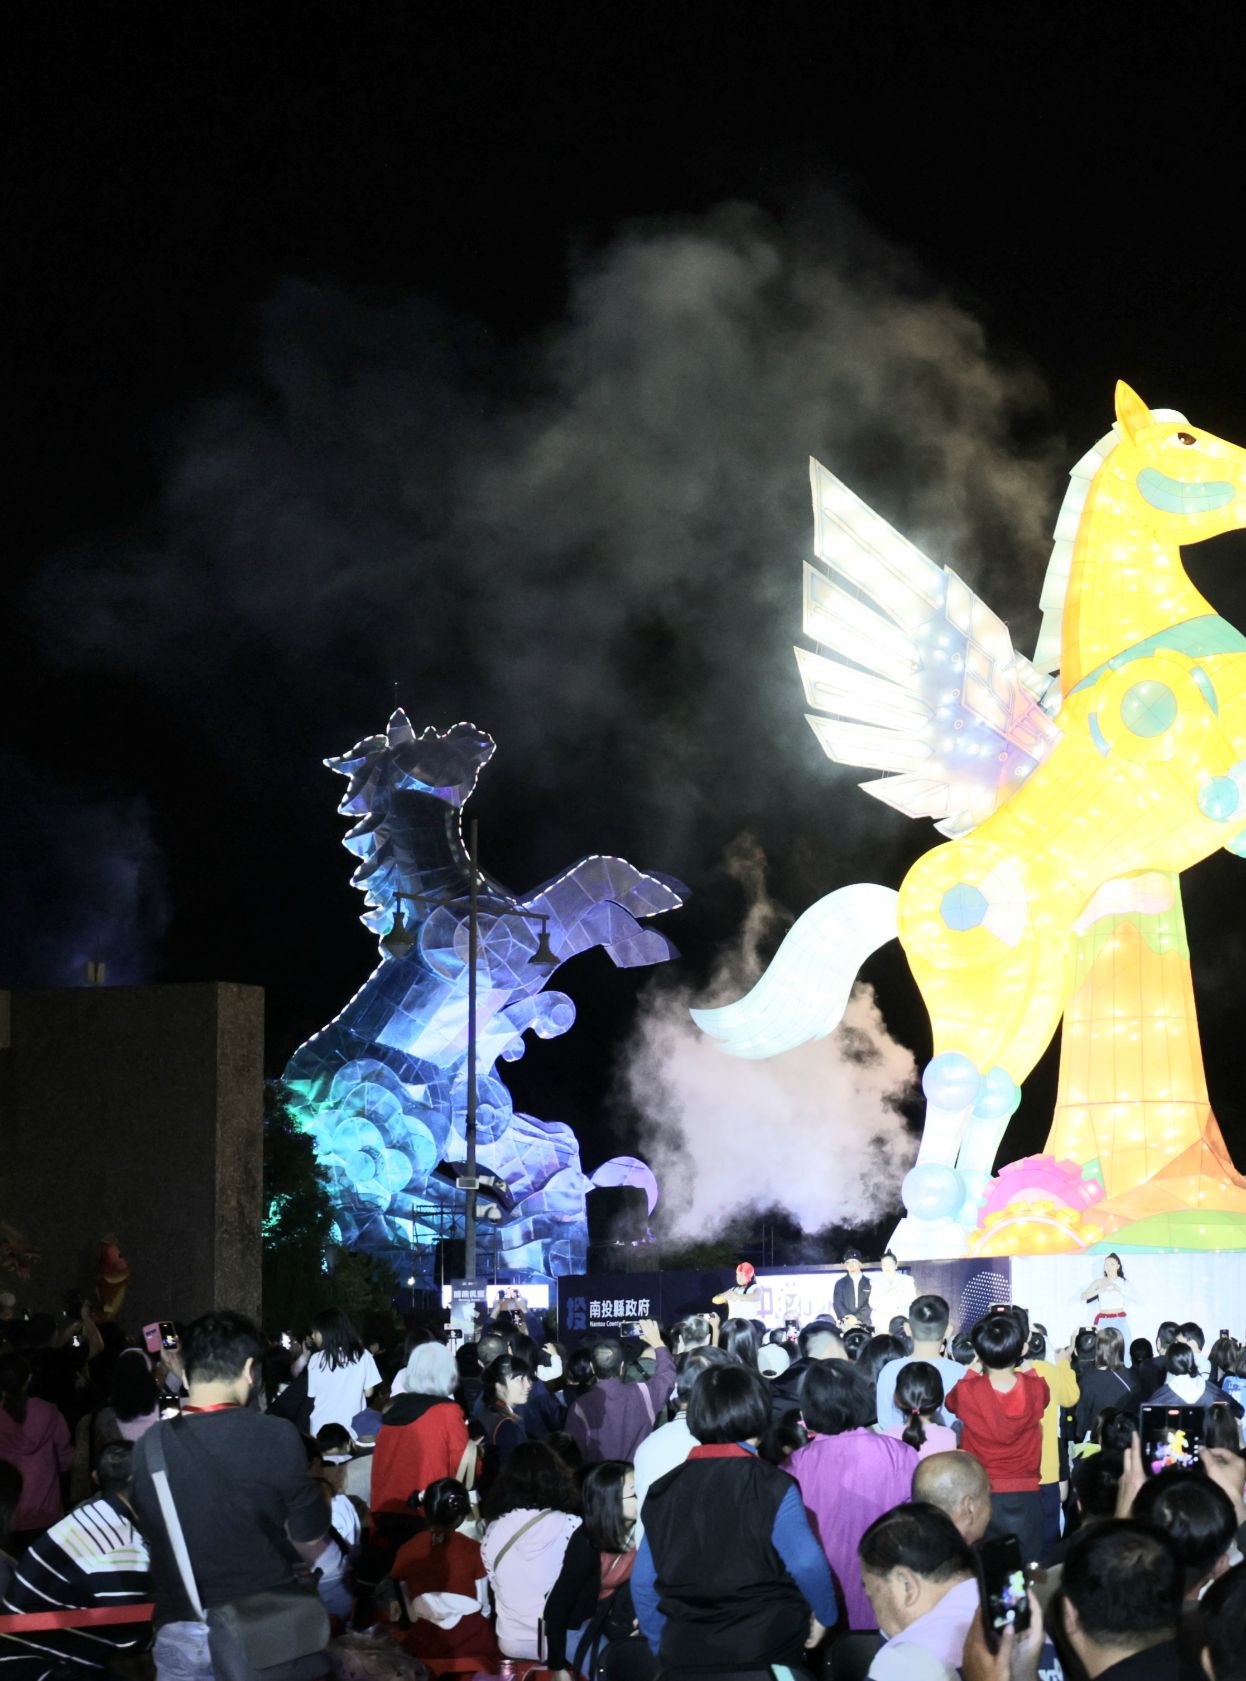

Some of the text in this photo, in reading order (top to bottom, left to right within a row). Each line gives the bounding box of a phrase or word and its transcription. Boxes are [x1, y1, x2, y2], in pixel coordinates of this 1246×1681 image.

[589, 1299, 650, 1318] 南投縣政府
